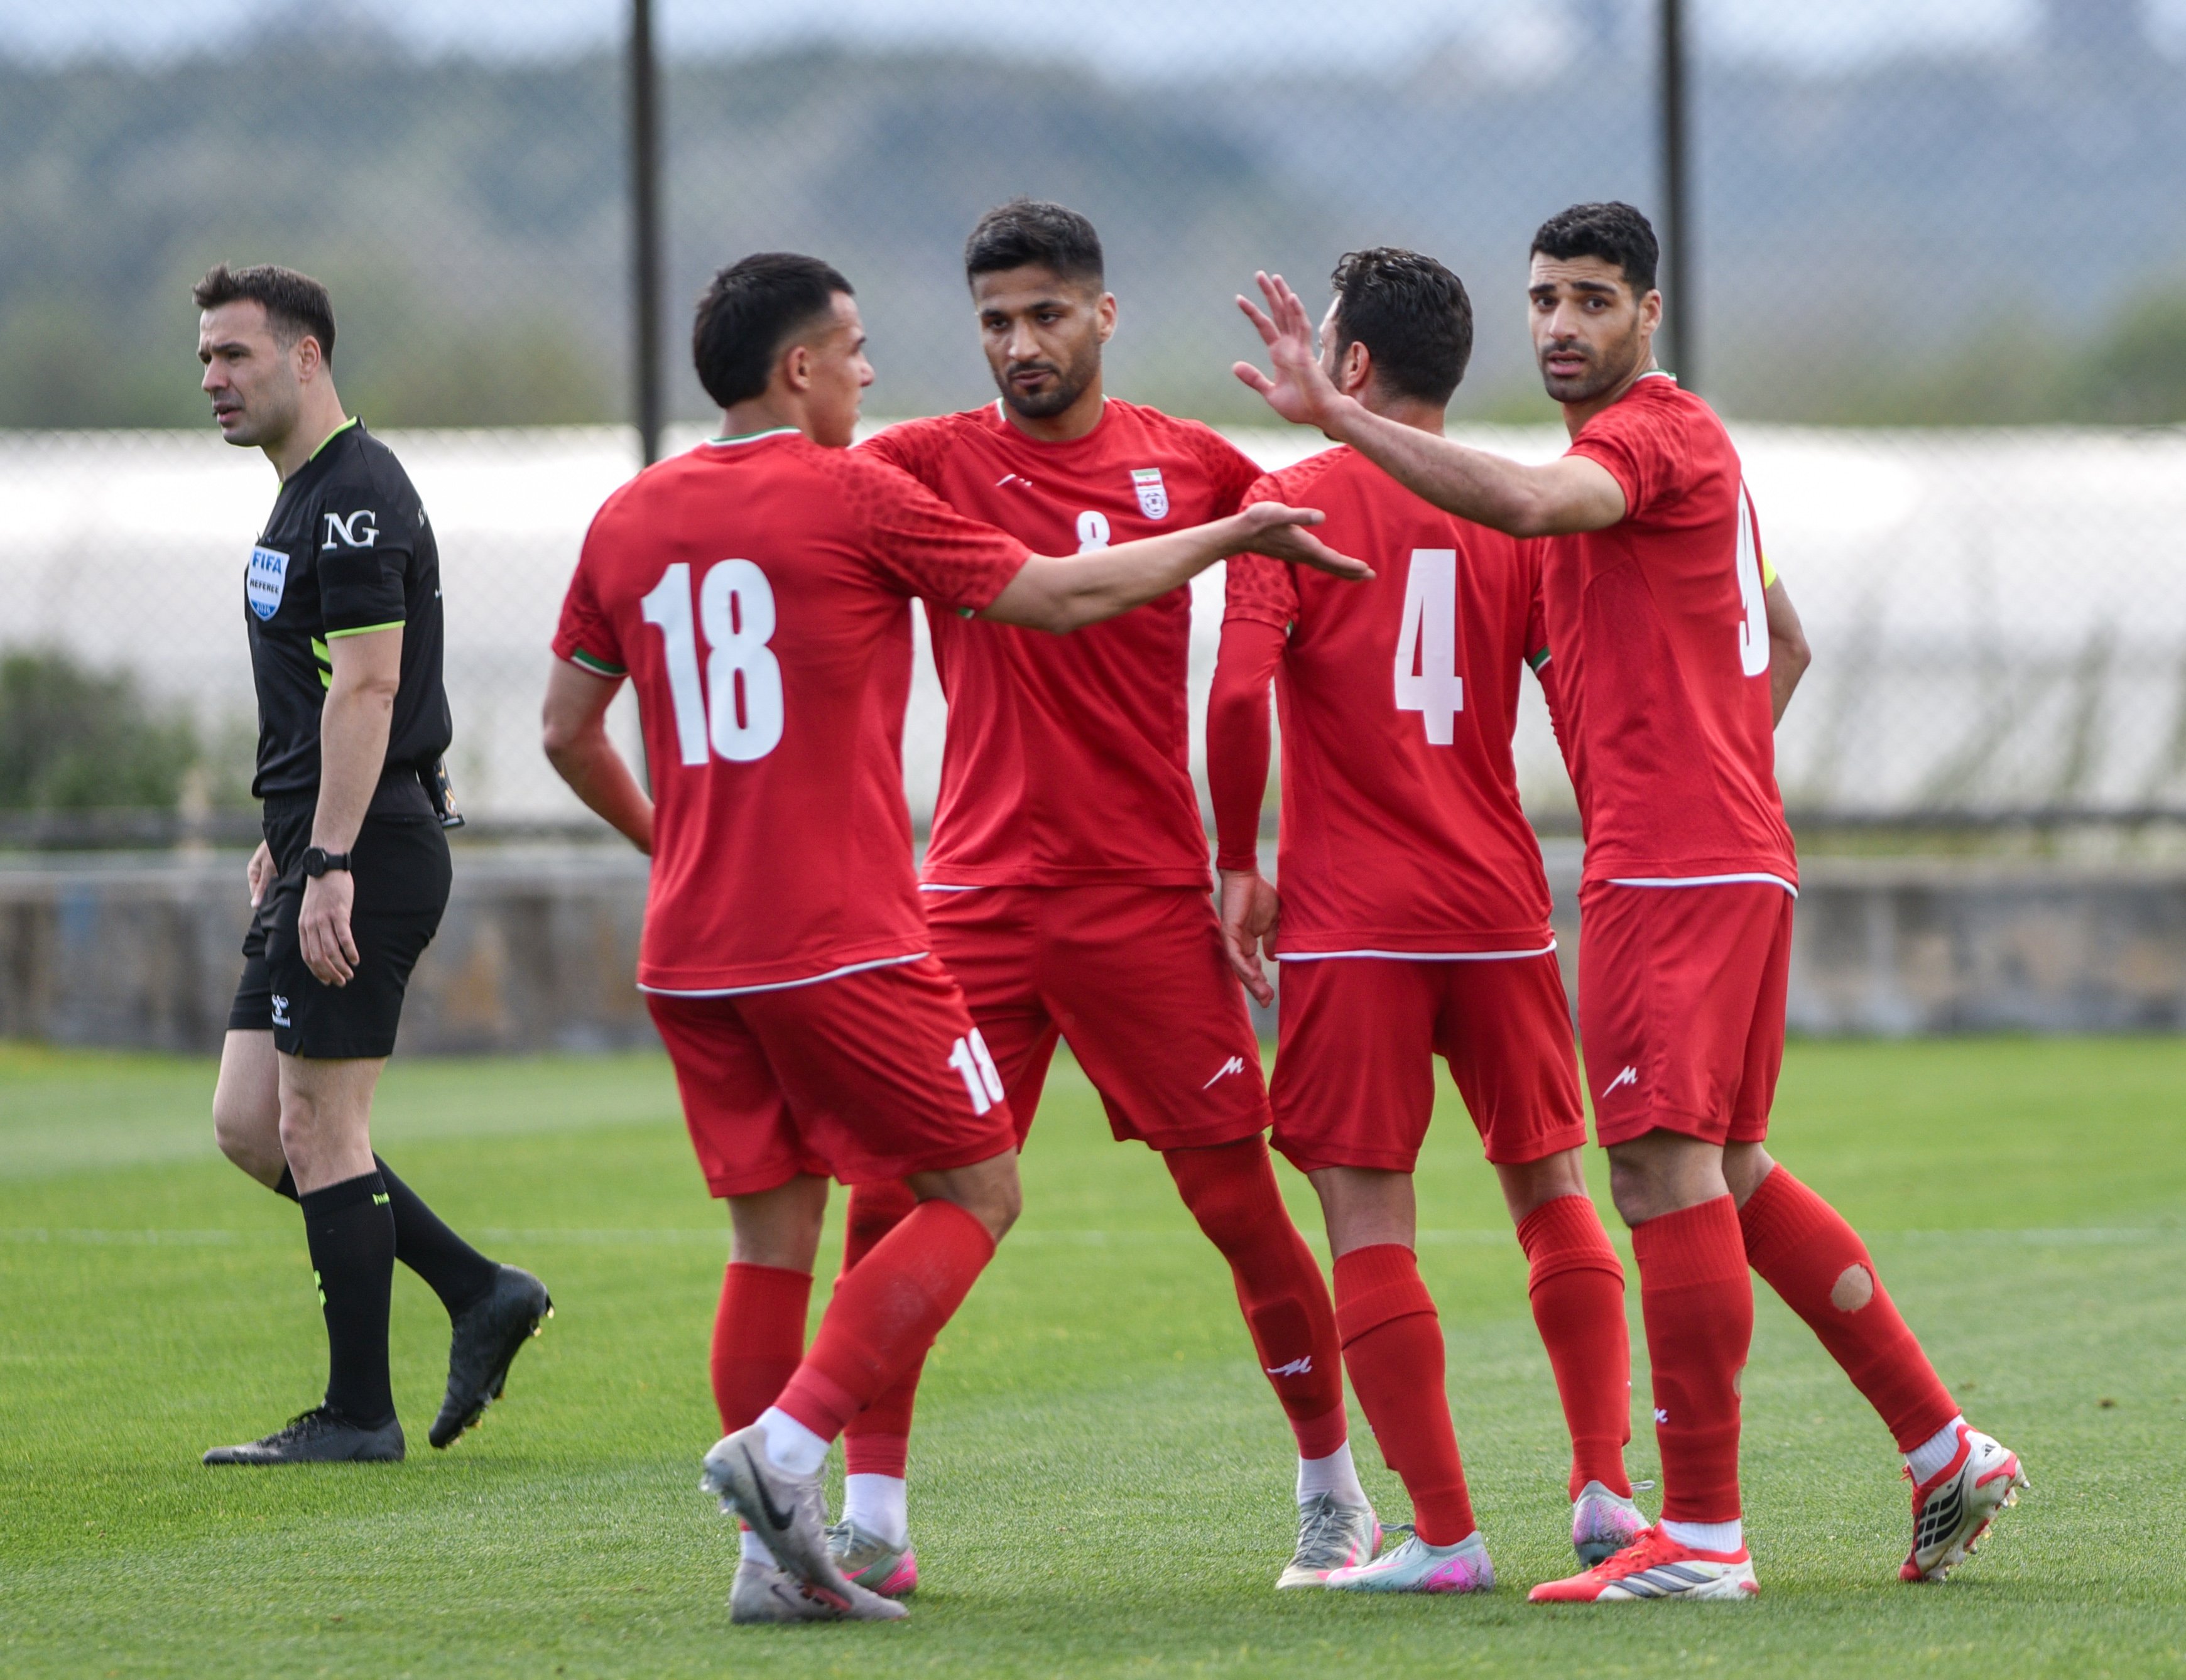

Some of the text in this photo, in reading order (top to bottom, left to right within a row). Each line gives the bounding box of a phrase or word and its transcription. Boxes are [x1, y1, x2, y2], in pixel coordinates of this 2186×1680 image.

[252, 551, 282, 575] FIFA
[322, 510, 379, 550] NG
[249, 577, 280, 595] REFEREE
[1736, 479, 1770, 676] 9
[640, 558, 785, 765] 18
[1395, 548, 1463, 745] 4
[948, 1027, 1004, 1115] 18
